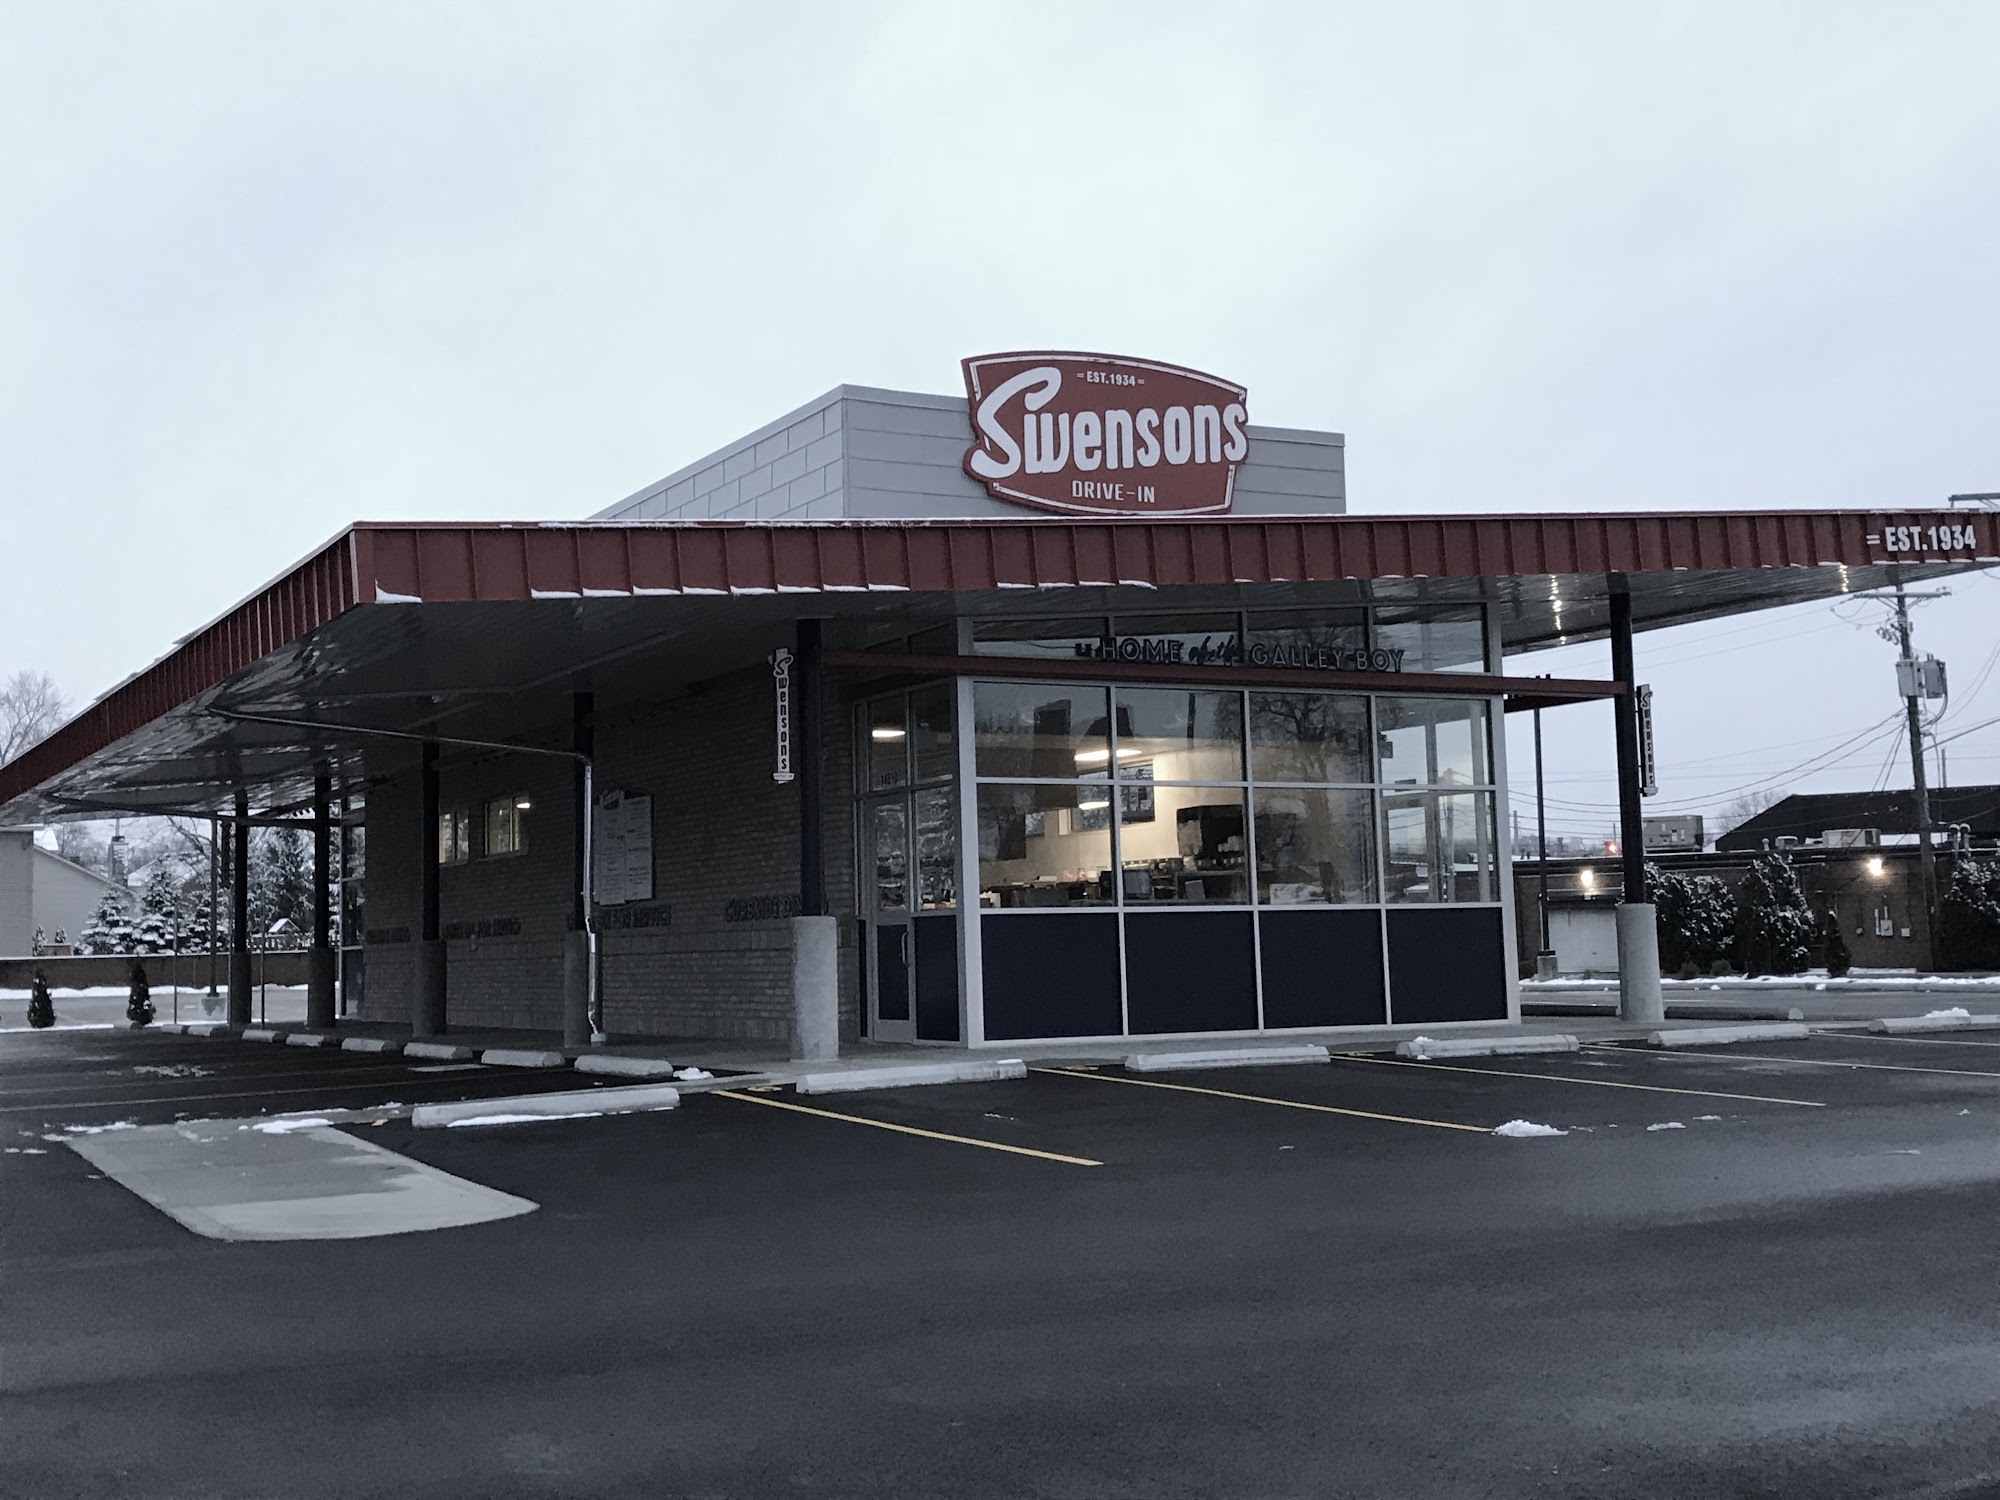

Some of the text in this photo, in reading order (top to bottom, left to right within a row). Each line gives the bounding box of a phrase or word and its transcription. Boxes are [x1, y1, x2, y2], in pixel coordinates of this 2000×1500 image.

[970, 366, 1248, 479] Swensons
[1071, 480, 1155, 503] DRIVE-IN
[1100, 637, 1184, 664] HOME
[1250, 642, 1343, 670] GALLEY
[1356, 648, 1405, 672] BOY
[775, 655, 792, 770] Swensons
